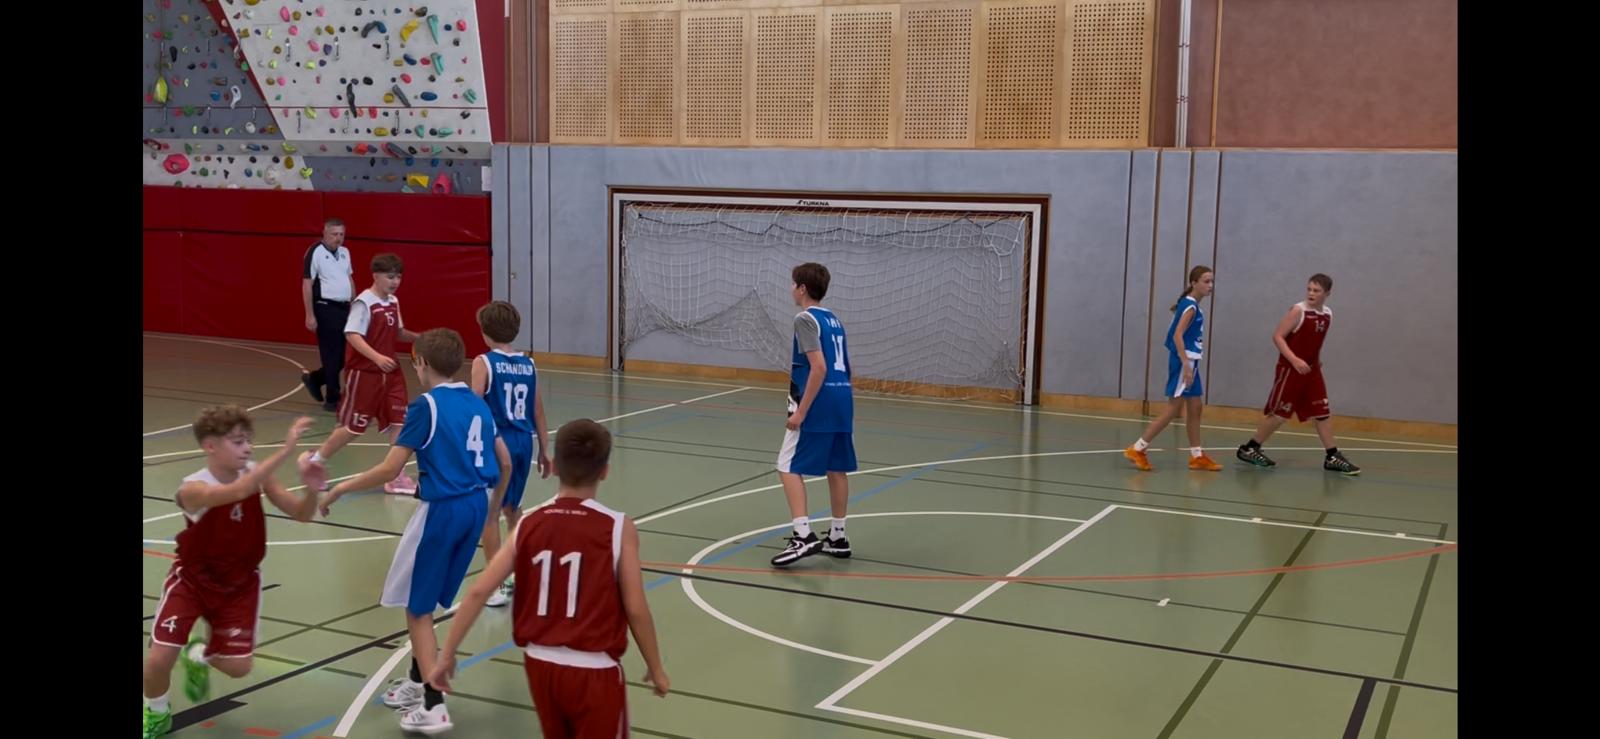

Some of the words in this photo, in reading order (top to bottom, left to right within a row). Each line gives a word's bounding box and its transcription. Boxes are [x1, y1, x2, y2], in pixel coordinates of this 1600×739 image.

[503, 382, 529, 420] 18
[353, 412, 368, 427] 15
[466, 414, 484, 467] 4
[230, 503, 244, 522] 4
[531, 549, 582, 618] 11
[160, 615, 178, 634] 4
